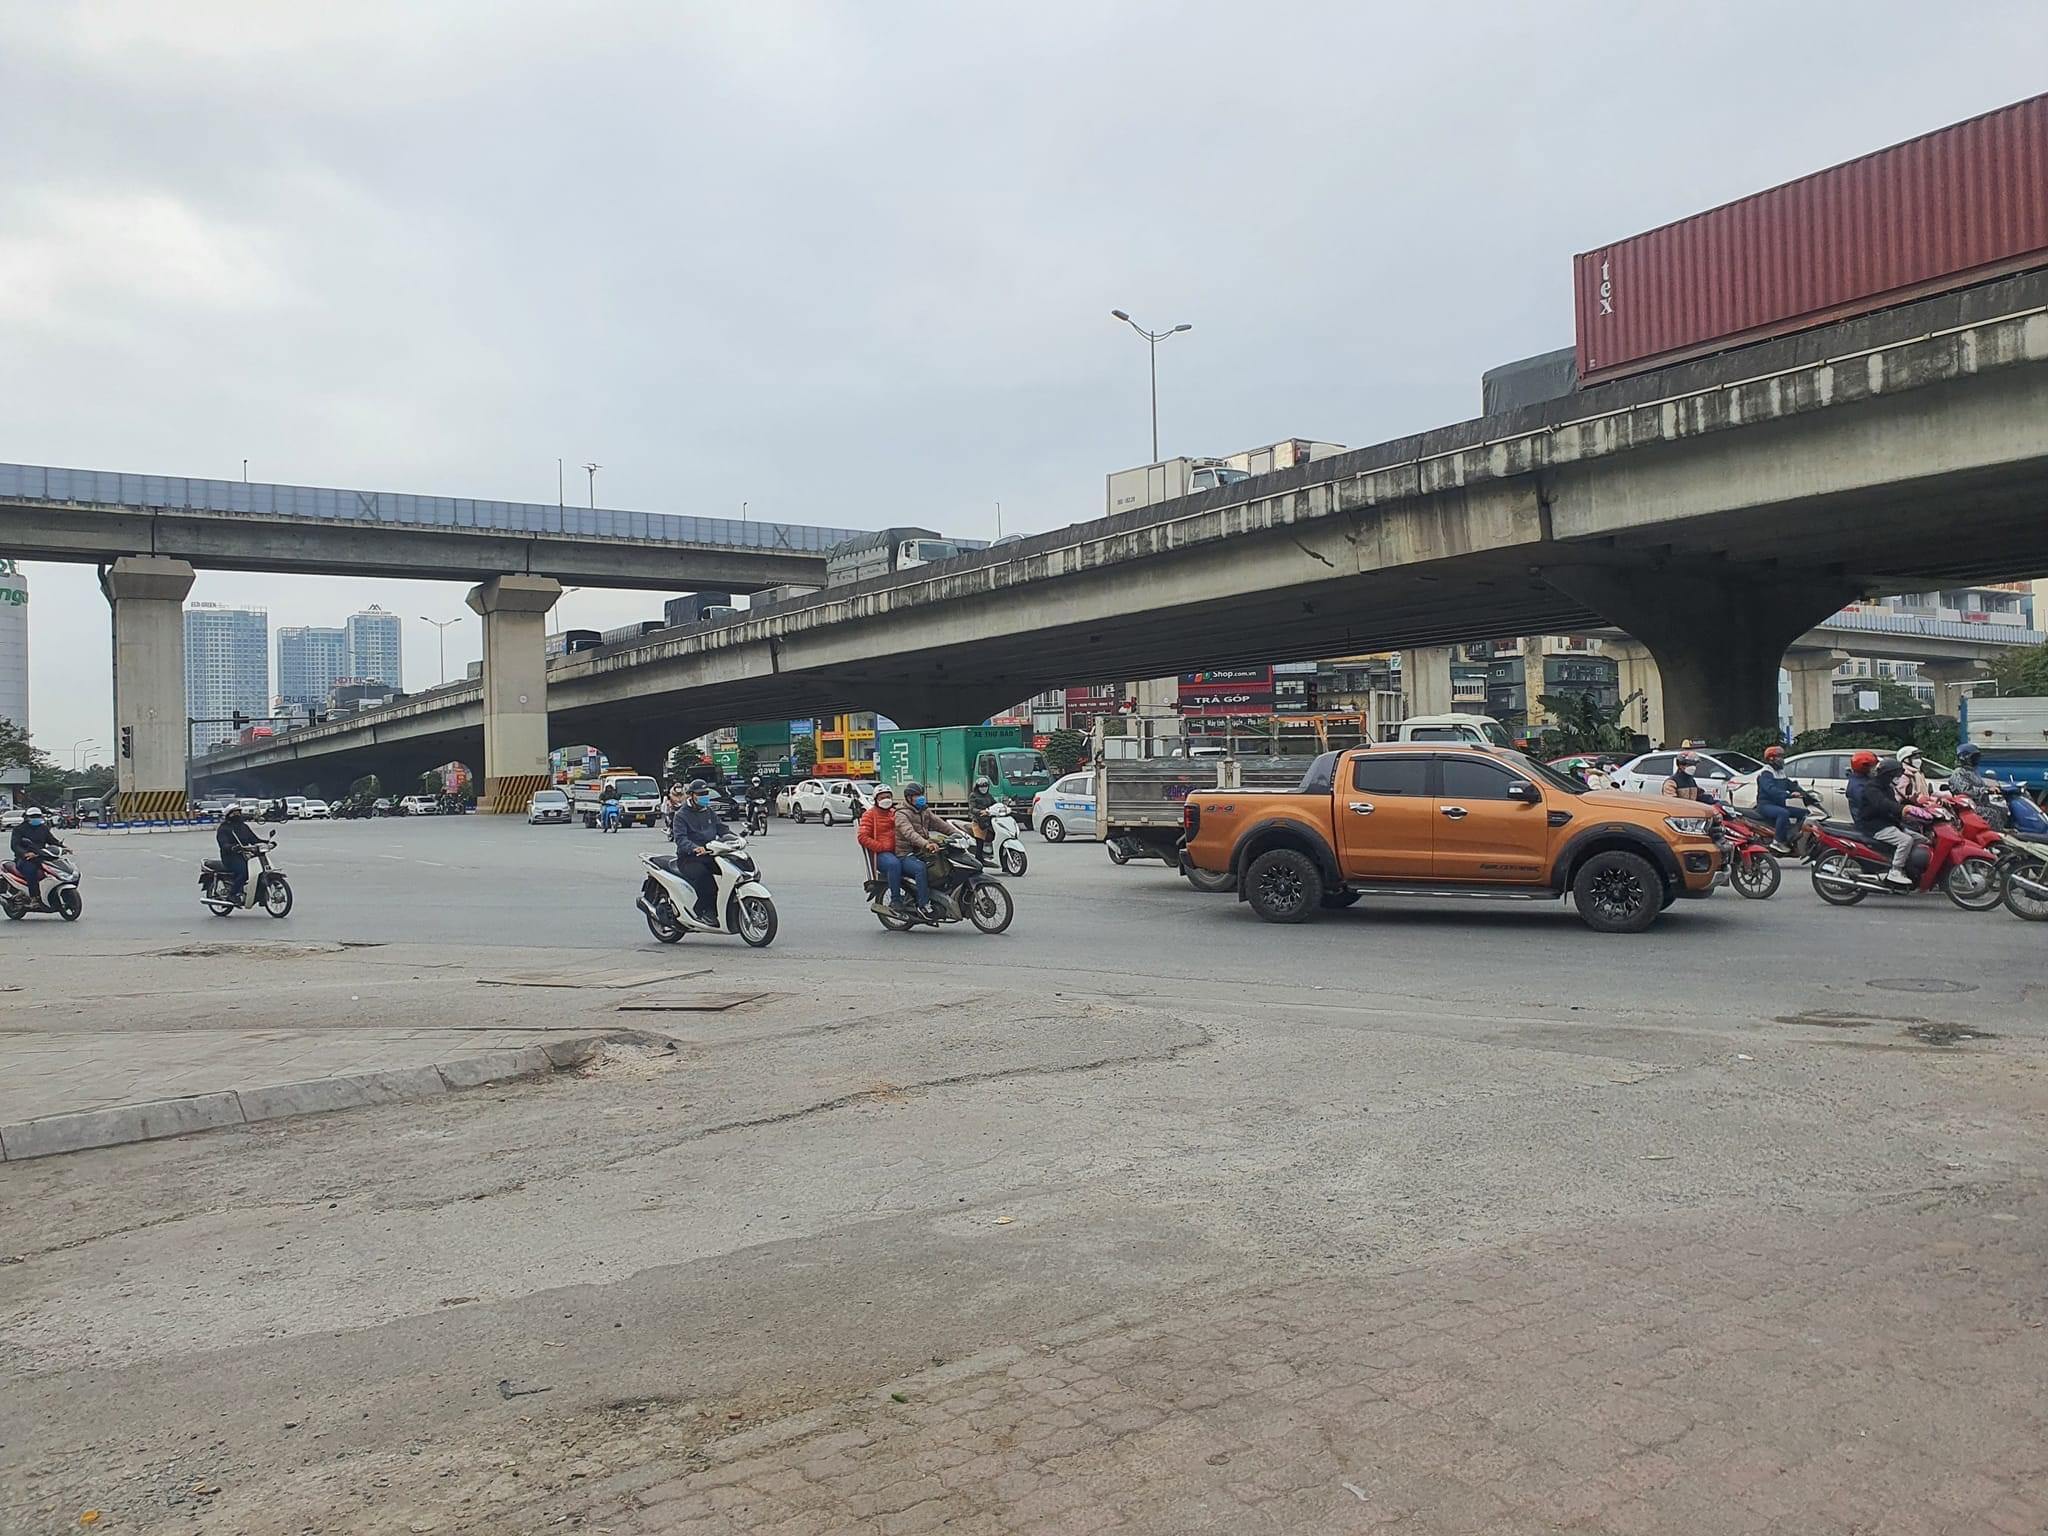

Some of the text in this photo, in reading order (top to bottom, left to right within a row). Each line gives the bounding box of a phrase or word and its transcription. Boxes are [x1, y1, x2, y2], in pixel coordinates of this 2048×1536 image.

[1600, 260, 1614, 316] tex
[1194, 693, 1250, 704] TRẢ GÓP
